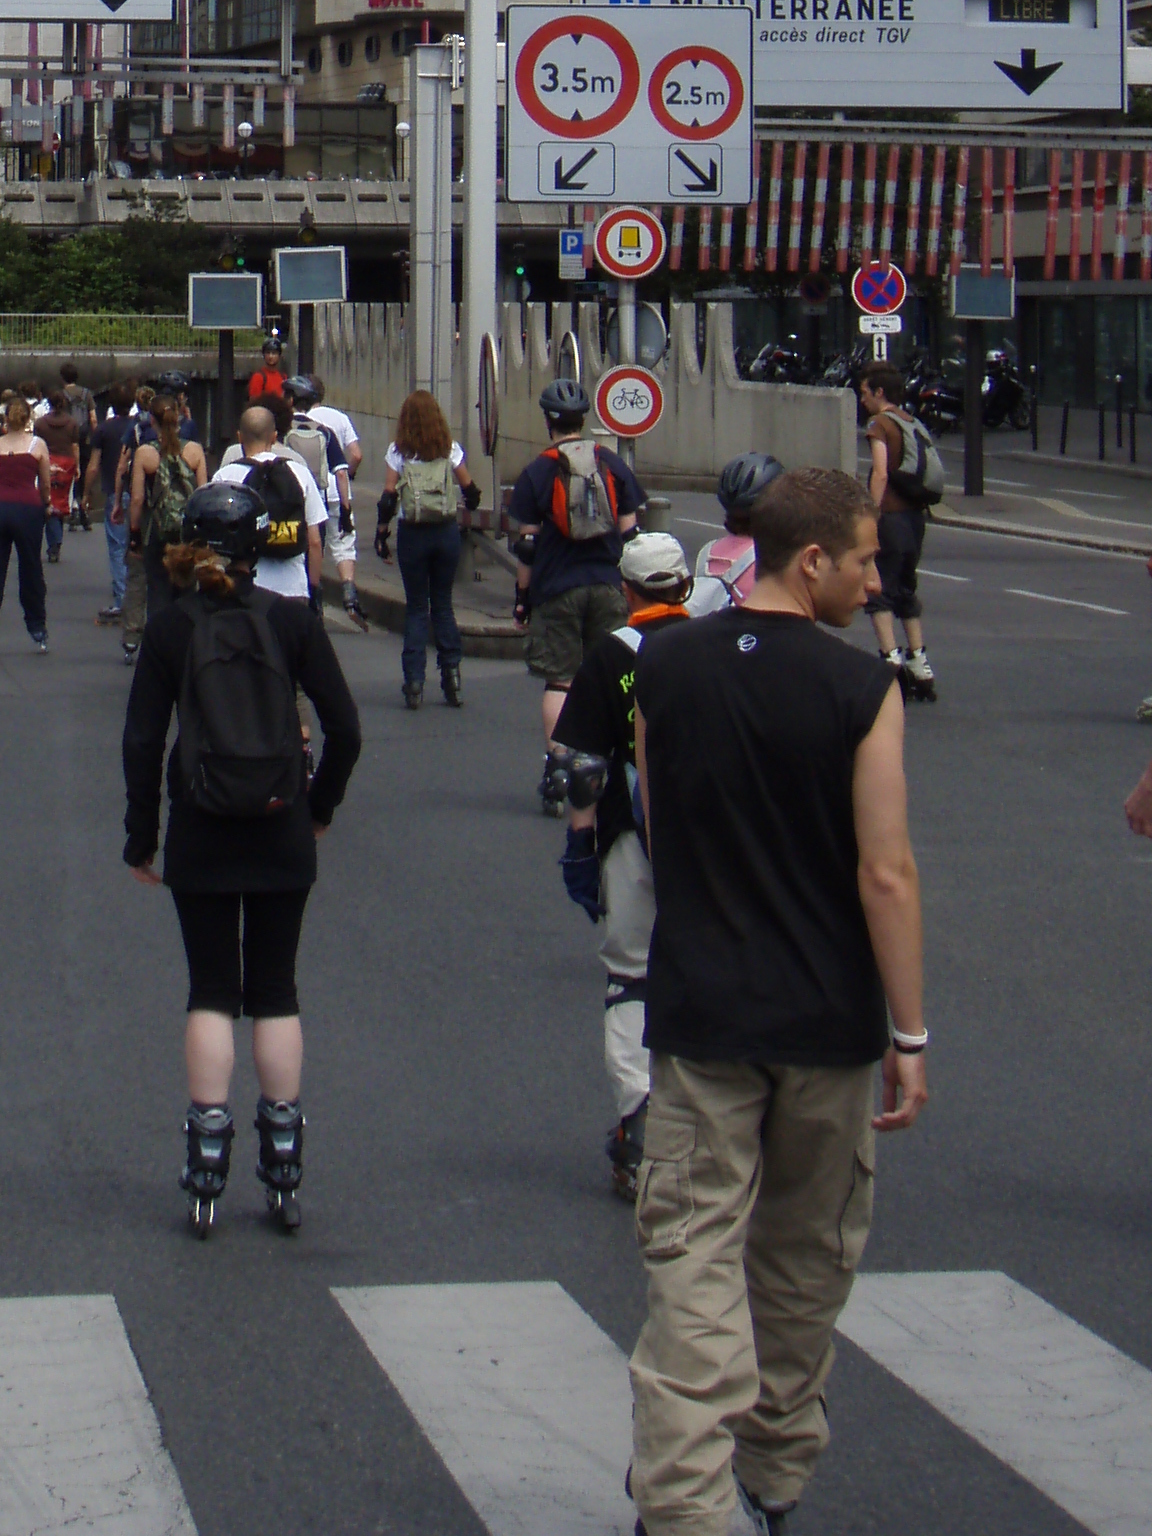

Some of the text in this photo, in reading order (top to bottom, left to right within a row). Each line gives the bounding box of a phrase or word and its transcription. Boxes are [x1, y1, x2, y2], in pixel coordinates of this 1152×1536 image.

[1000, 0, 1054, 19] LIBRE
[760, 27, 910, 43] accès direct TGV
[541, 63, 615, 93] 3.5m
[666, 82, 725, 105] 2.5m
[567, 236, 578, 252] P
